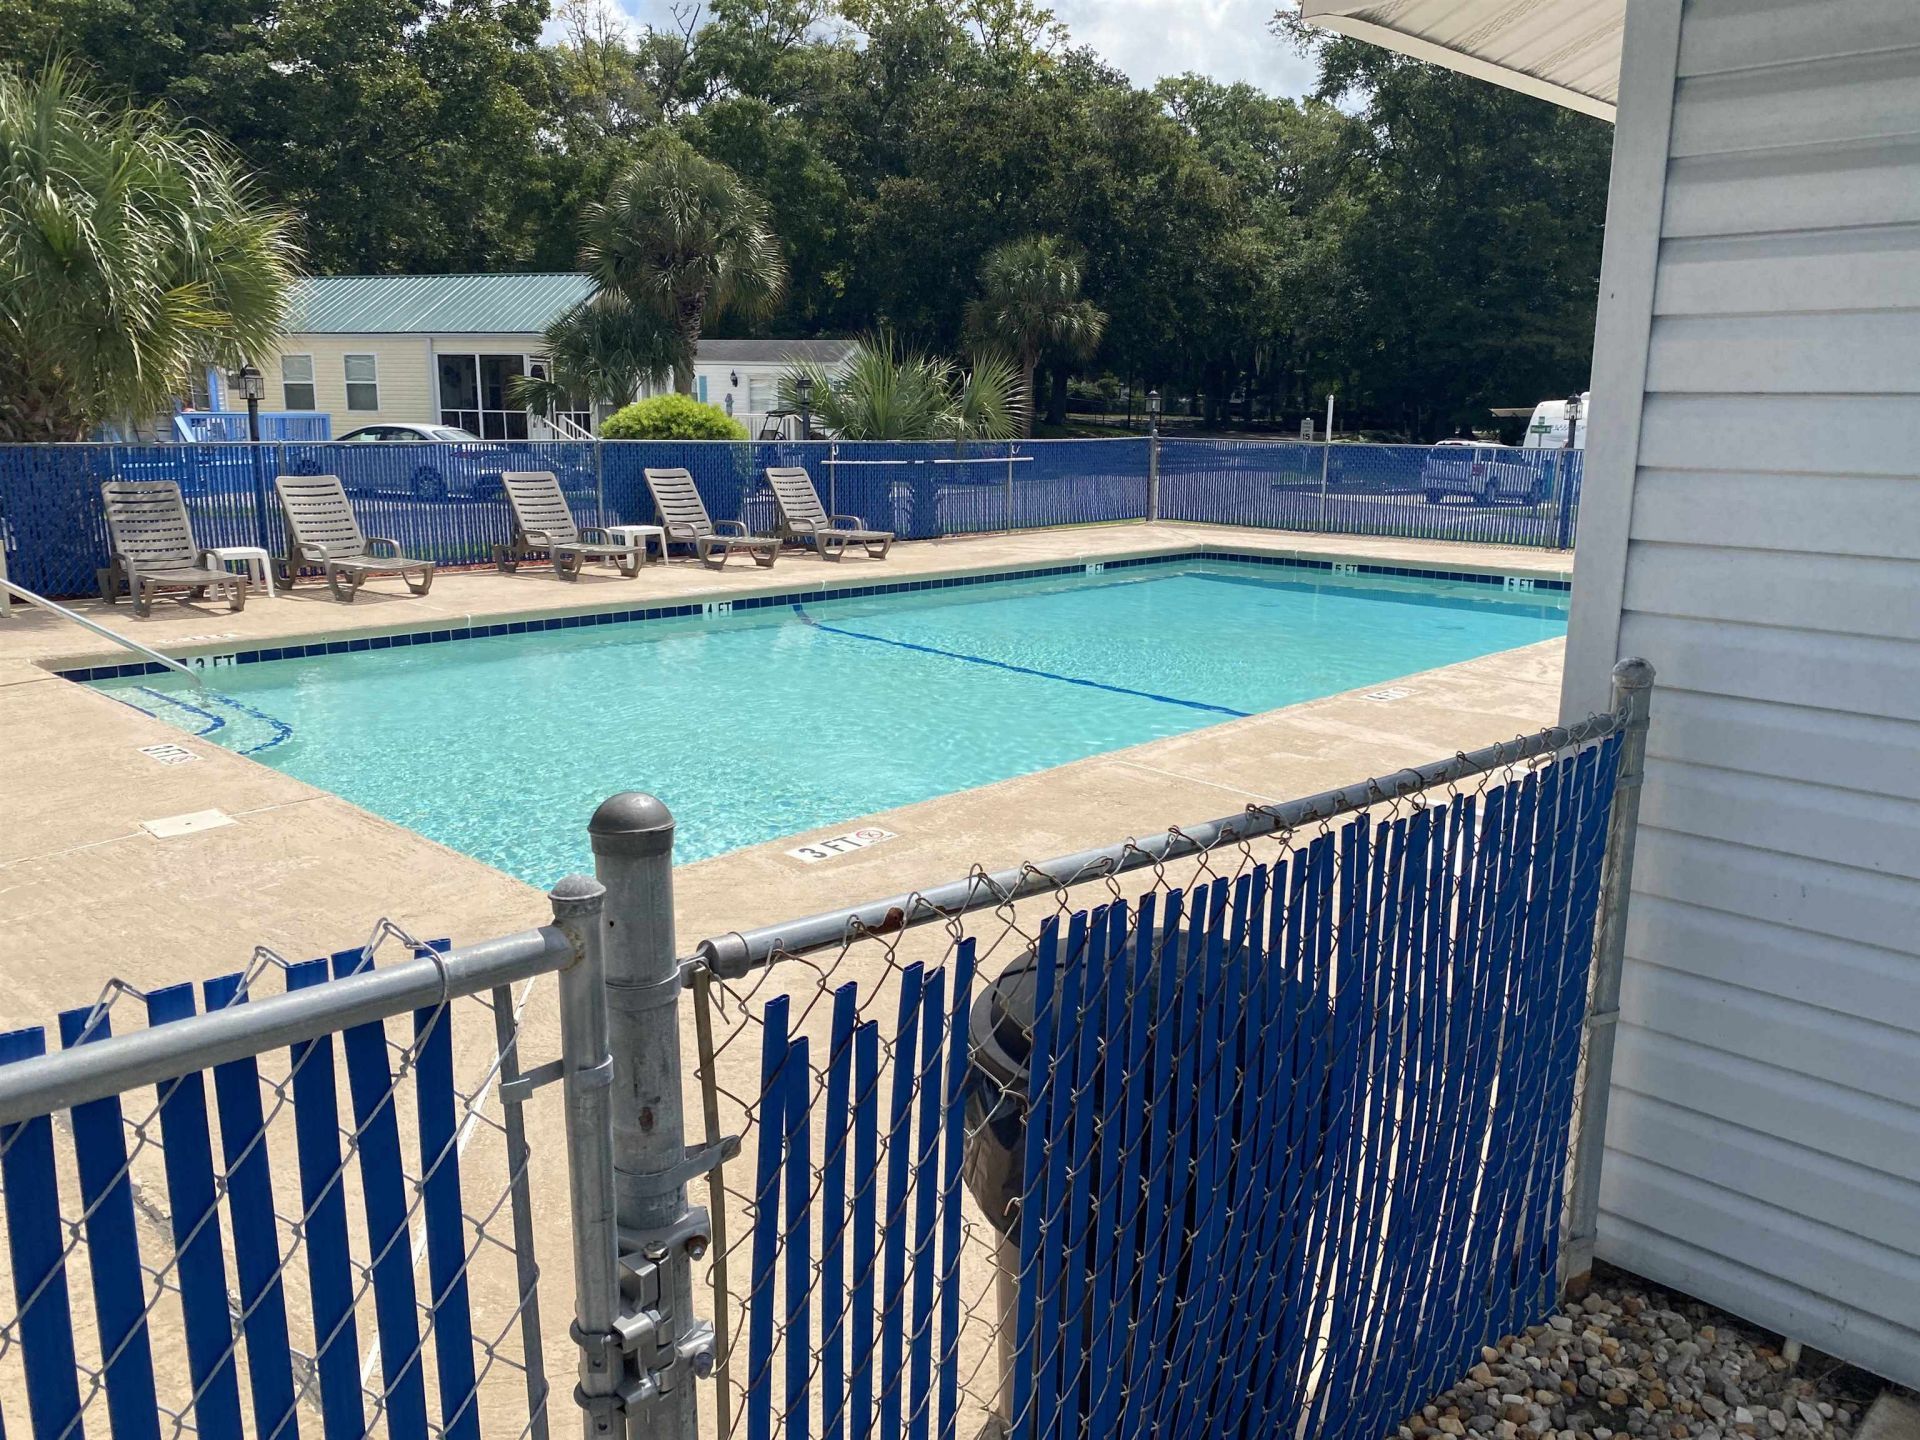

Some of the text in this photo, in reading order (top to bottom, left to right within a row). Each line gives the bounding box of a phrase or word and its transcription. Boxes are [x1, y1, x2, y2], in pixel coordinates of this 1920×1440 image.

[1302, 432, 1311, 440] 15
[1520, 578, 1533, 588] FT
[718, 601, 732, 612] FT
[798, 836, 863, 859] 3 FT
